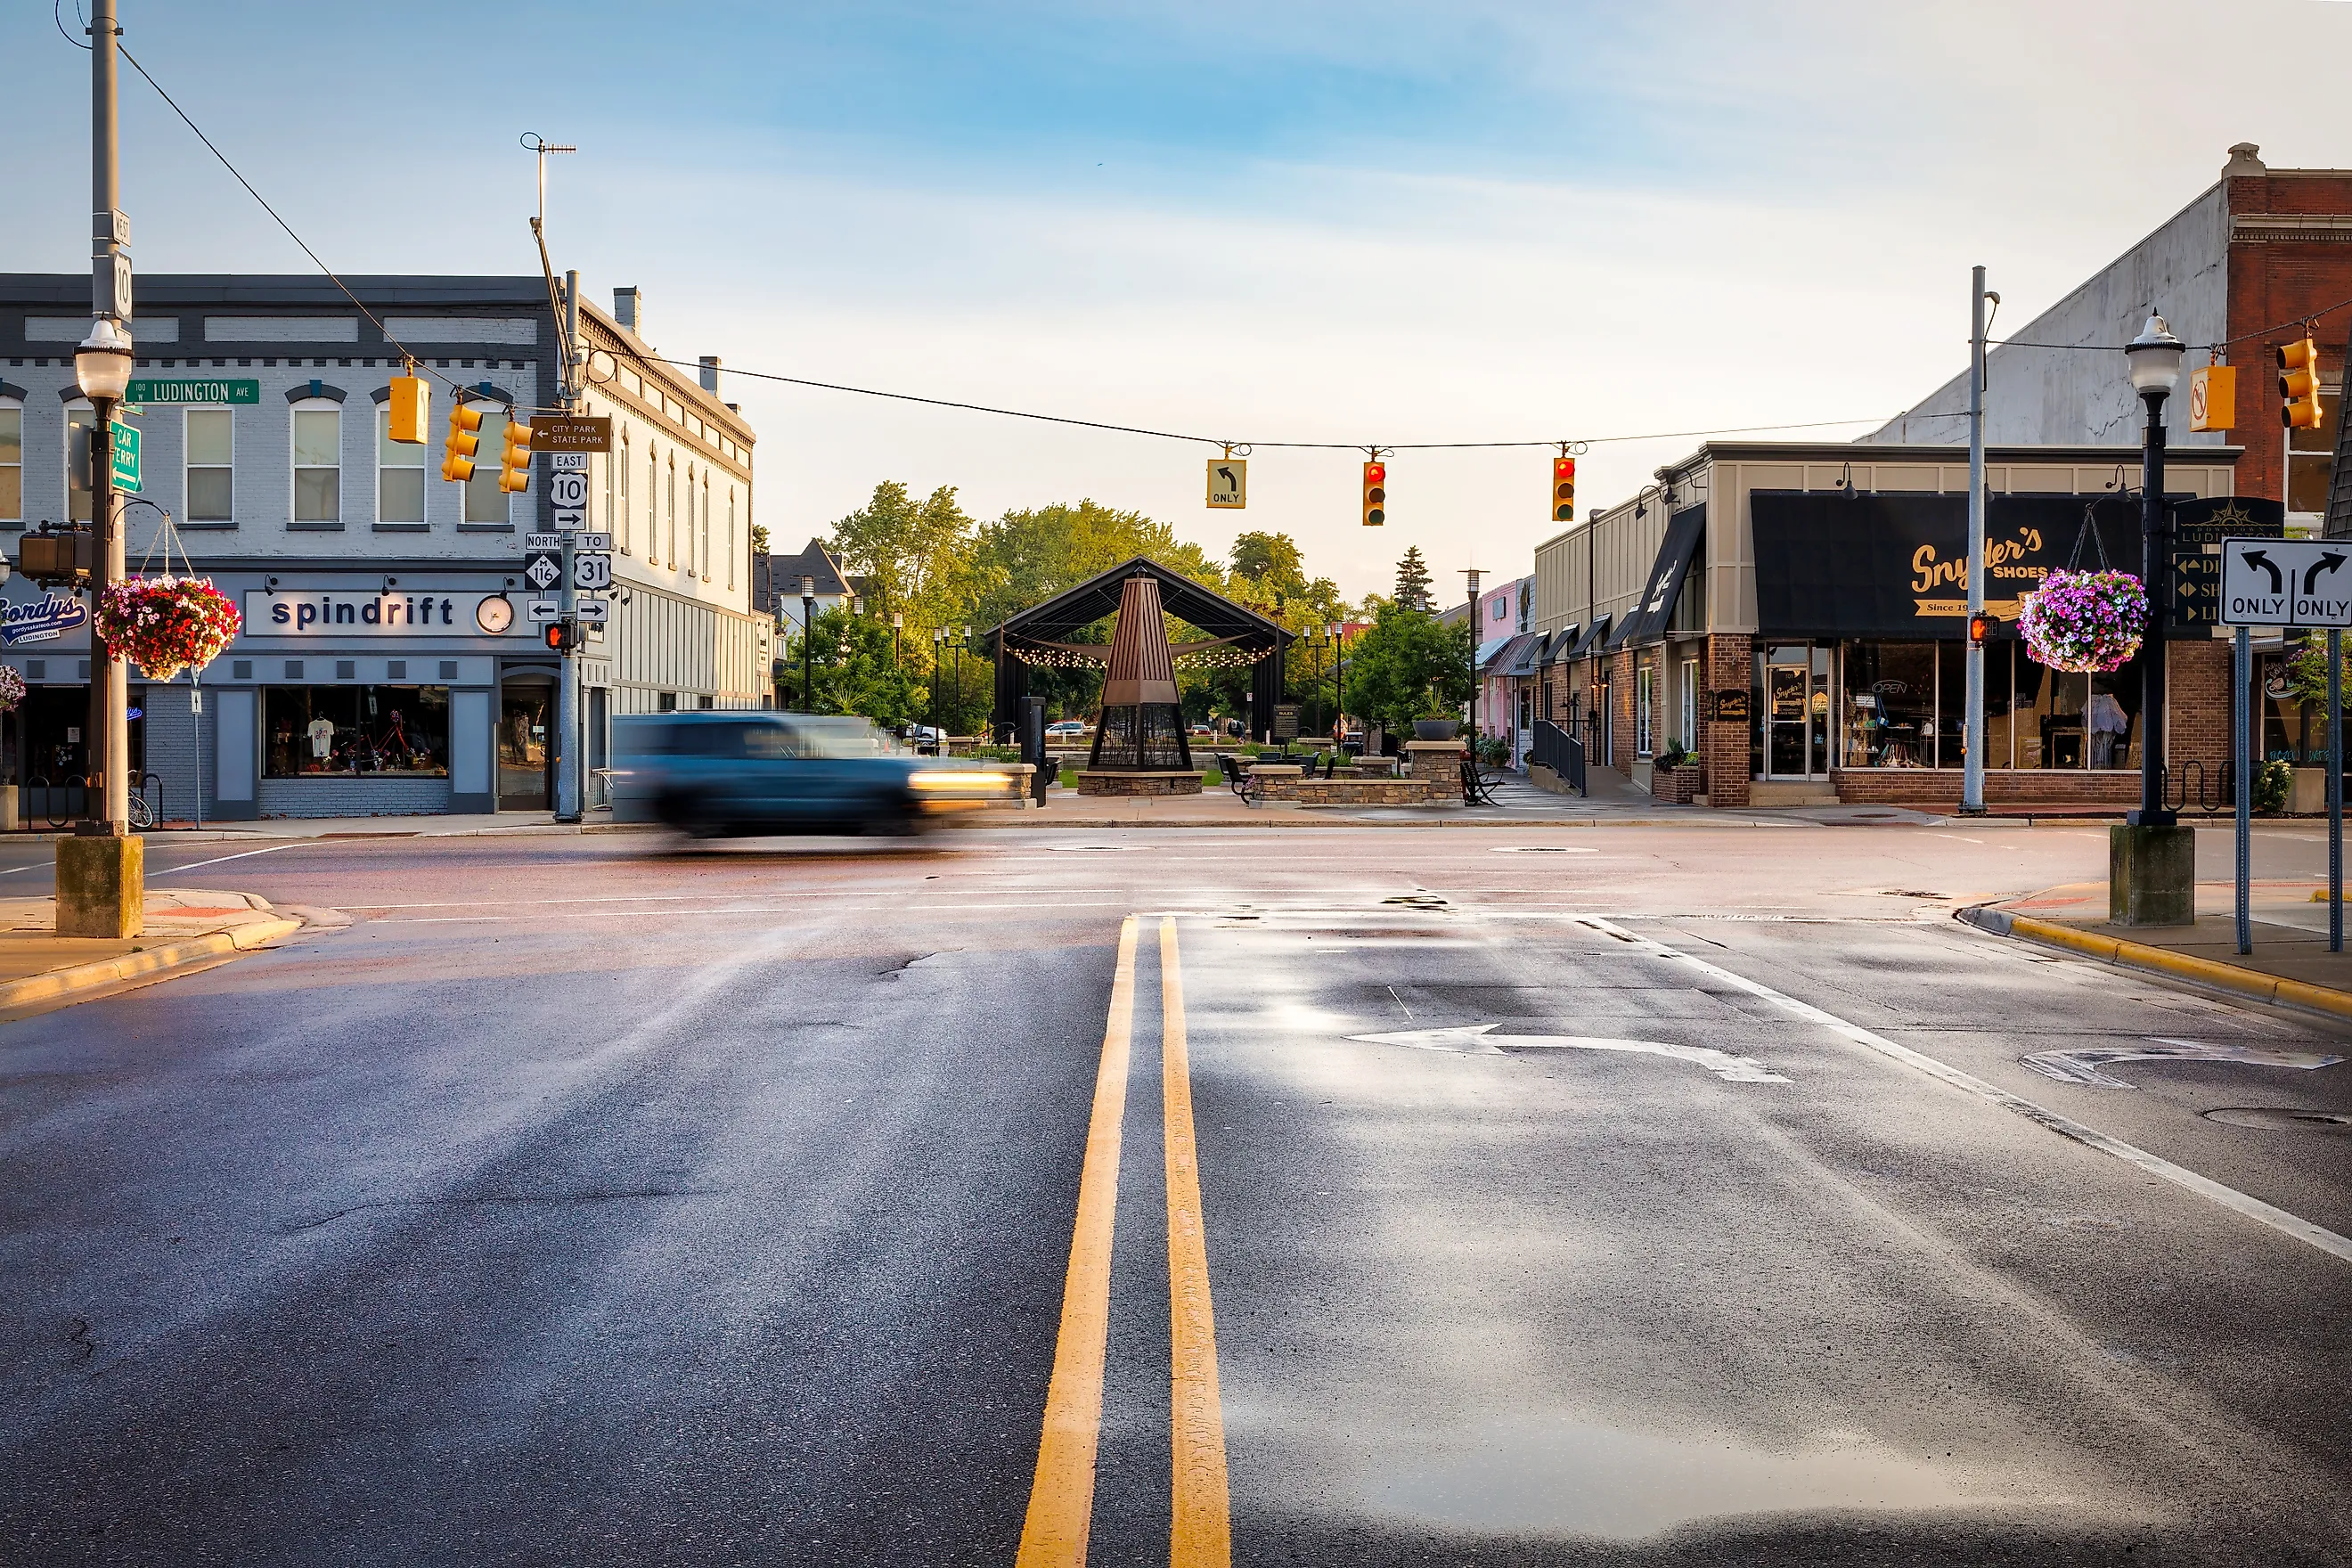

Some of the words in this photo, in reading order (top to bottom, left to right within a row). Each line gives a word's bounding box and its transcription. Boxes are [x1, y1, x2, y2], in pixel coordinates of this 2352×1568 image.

[115, 215, 128, 239] WEST
[118, 266, 129, 304] 10
[135, 383, 146, 392] 100
[153, 383, 229, 401] LUDINGTON
[235, 387, 249, 397] AVE
[551, 425, 570, 433] CITY
[573, 425, 597, 433] PARK
[117, 428, 132, 448] CAR
[551, 436, 577, 444] STATE
[580, 436, 603, 445] PARK
[556, 455, 582, 467] EAST
[559, 479, 581, 500] 10
[1213, 493, 1240, 503] ONLY
[527, 536, 560, 547] NORTH
[584, 536, 602, 547] TO
[534, 567, 553, 582] 116
[581, 560, 603, 582] 31
[1993, 566, 2048, 579] SHOES
[1926, 603, 1954, 612] Since
[2232, 597, 2285, 615] ONLY
[2296, 600, 2350, 617] ONLY
[271, 596, 453, 631] spindrift
[19, 631, 58, 642] LUDINGTON
[1874, 683, 1907, 694] OPEN
